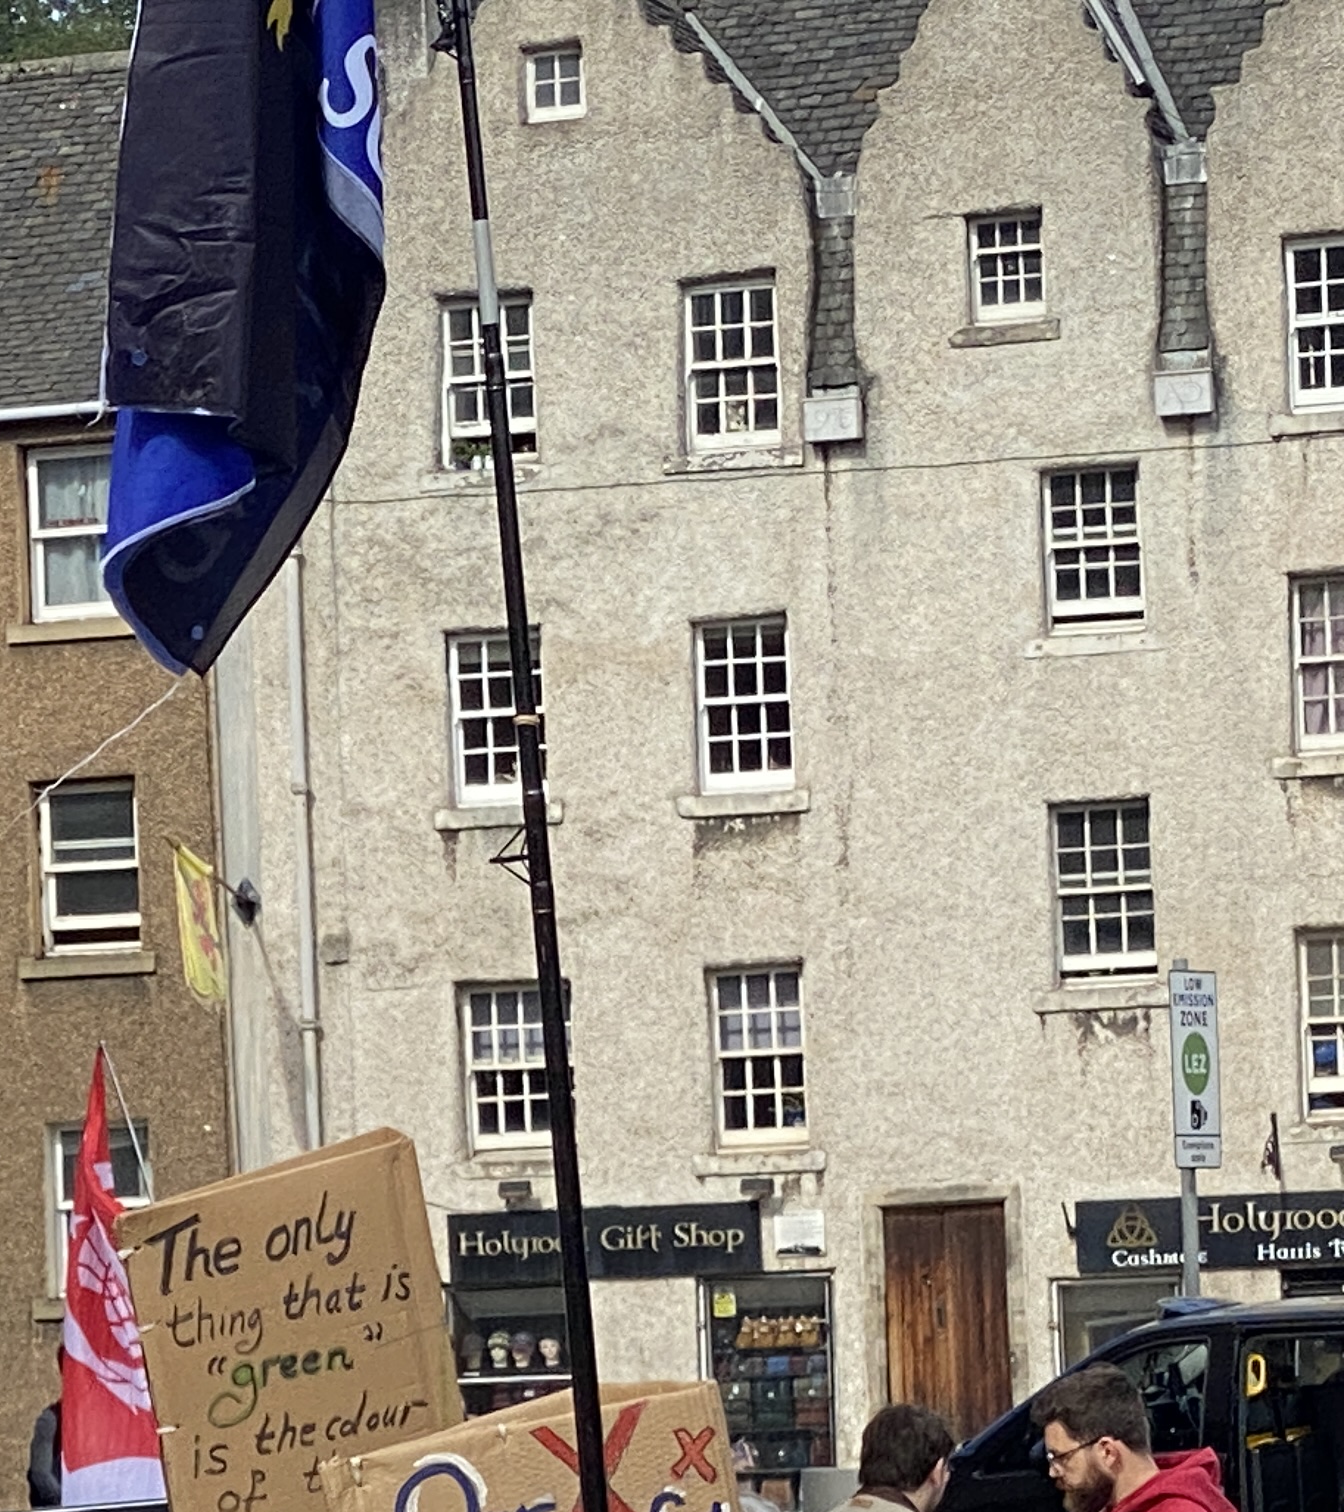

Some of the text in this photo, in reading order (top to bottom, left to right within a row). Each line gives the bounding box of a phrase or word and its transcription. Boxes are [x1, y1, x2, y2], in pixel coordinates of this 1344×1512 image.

[1173, 992, 1214, 1007] EMISSION
[1184, 977, 1203, 991] LOW
[1180, 1011, 1209, 1027] ZONE
[1184, 1053, 1208, 1075] LEZ
[1197, 1201, 1344, 1241] Holyroo
[143, 1191, 357, 1296] The only
[600, 1223, 663, 1253] Gift
[673, 1222, 745, 1254] Shop
[166, 1264, 412, 1355] thing that is
[193, 1389, 429, 1480] is the colour
